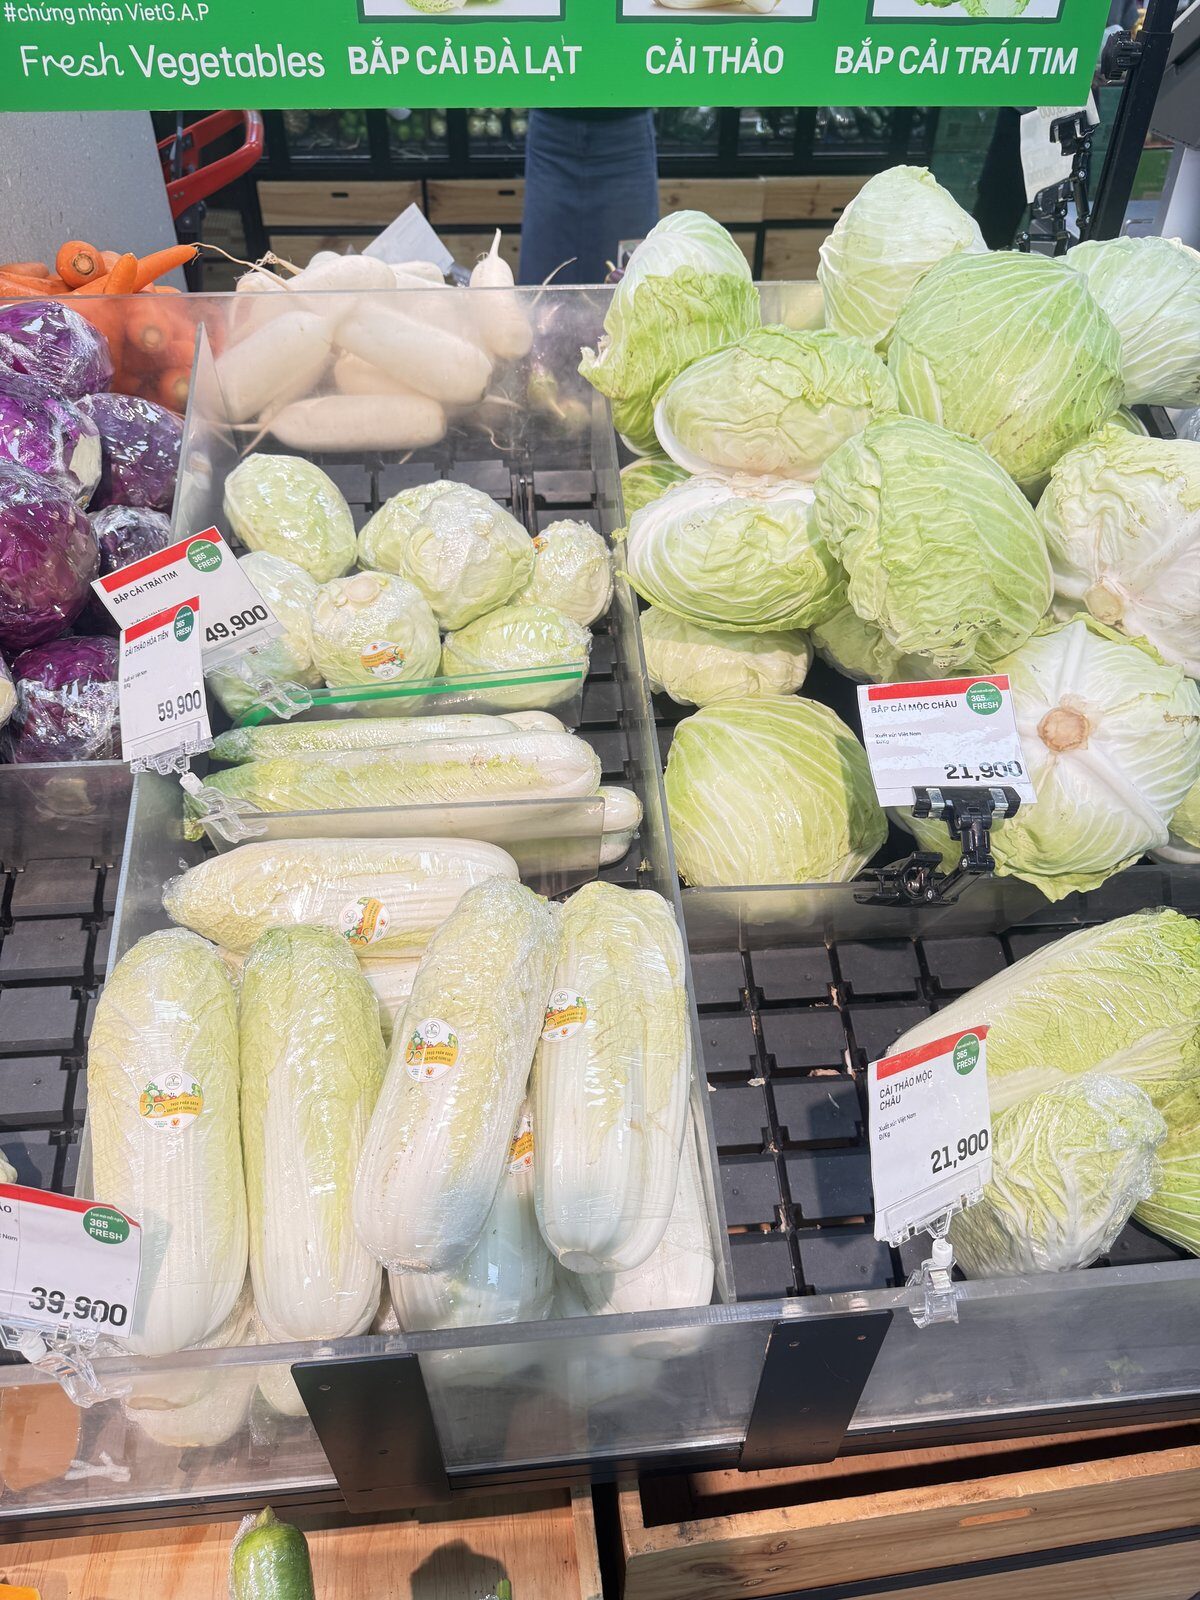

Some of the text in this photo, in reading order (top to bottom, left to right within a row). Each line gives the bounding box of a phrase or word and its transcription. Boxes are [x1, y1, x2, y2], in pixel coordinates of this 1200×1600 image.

[3, 2, 210, 26] #chứng nhận VietG.A.P
[20, 41, 326, 86] Fresh Vegetables
[347, 36, 583, 82] BẮP CẢI ĐÀ LẠT
[645, 37, 785, 75] CẢI THẢO
[834, 36, 1079, 75] BẮP CẢI TRÁI TIM
[193, 553, 206, 563] 365
[197, 556, 221, 571] FRESH
[161, 570, 179, 582] TIM
[176, 624, 192, 638] FRESH
[204, 604, 269, 643] 49,900
[157, 689, 202, 722] 59,900
[931, 699, 958, 710] CHÂU
[970, 694, 986, 702] 365
[972, 701, 999, 710] FRESH
[943, 760, 1024, 782] 21,900
[956, 1048, 968, 1060] 365
[956, 1055, 977, 1071] FRESH
[915, 1069, 933, 1084] MỘC
[879, 1094, 901, 1111] CHÂU
[930, 1127, 990, 1175] 21,900
[89, 1218, 109, 1229] 365
[89, 1227, 123, 1242] FRESH
[28, 1286, 128, 1327] 39,900
